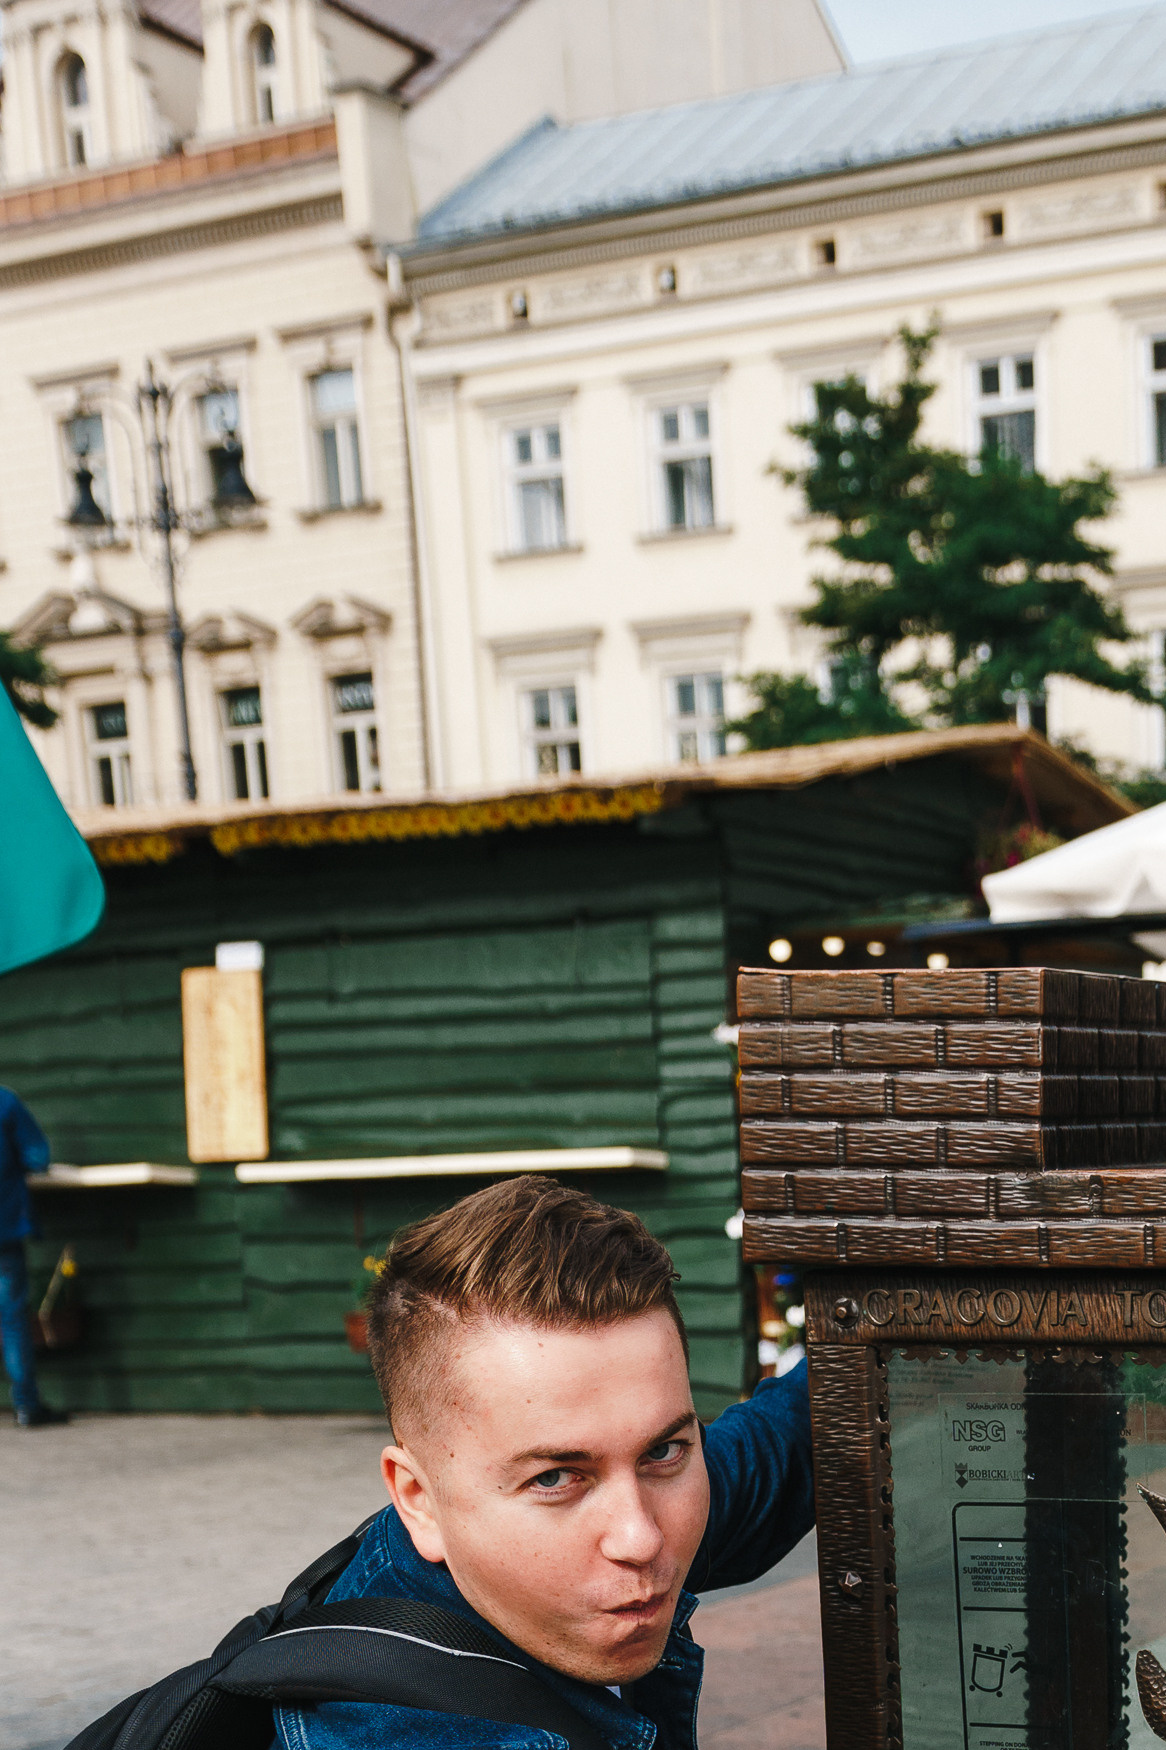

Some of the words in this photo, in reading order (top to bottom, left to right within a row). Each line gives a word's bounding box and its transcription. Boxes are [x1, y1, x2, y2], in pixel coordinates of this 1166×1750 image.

[863, 1287, 1087, 1330] CRACOVIA
[953, 1420, 1006, 1442] NSG
[963, 1567, 997, 1575] SUROWO
